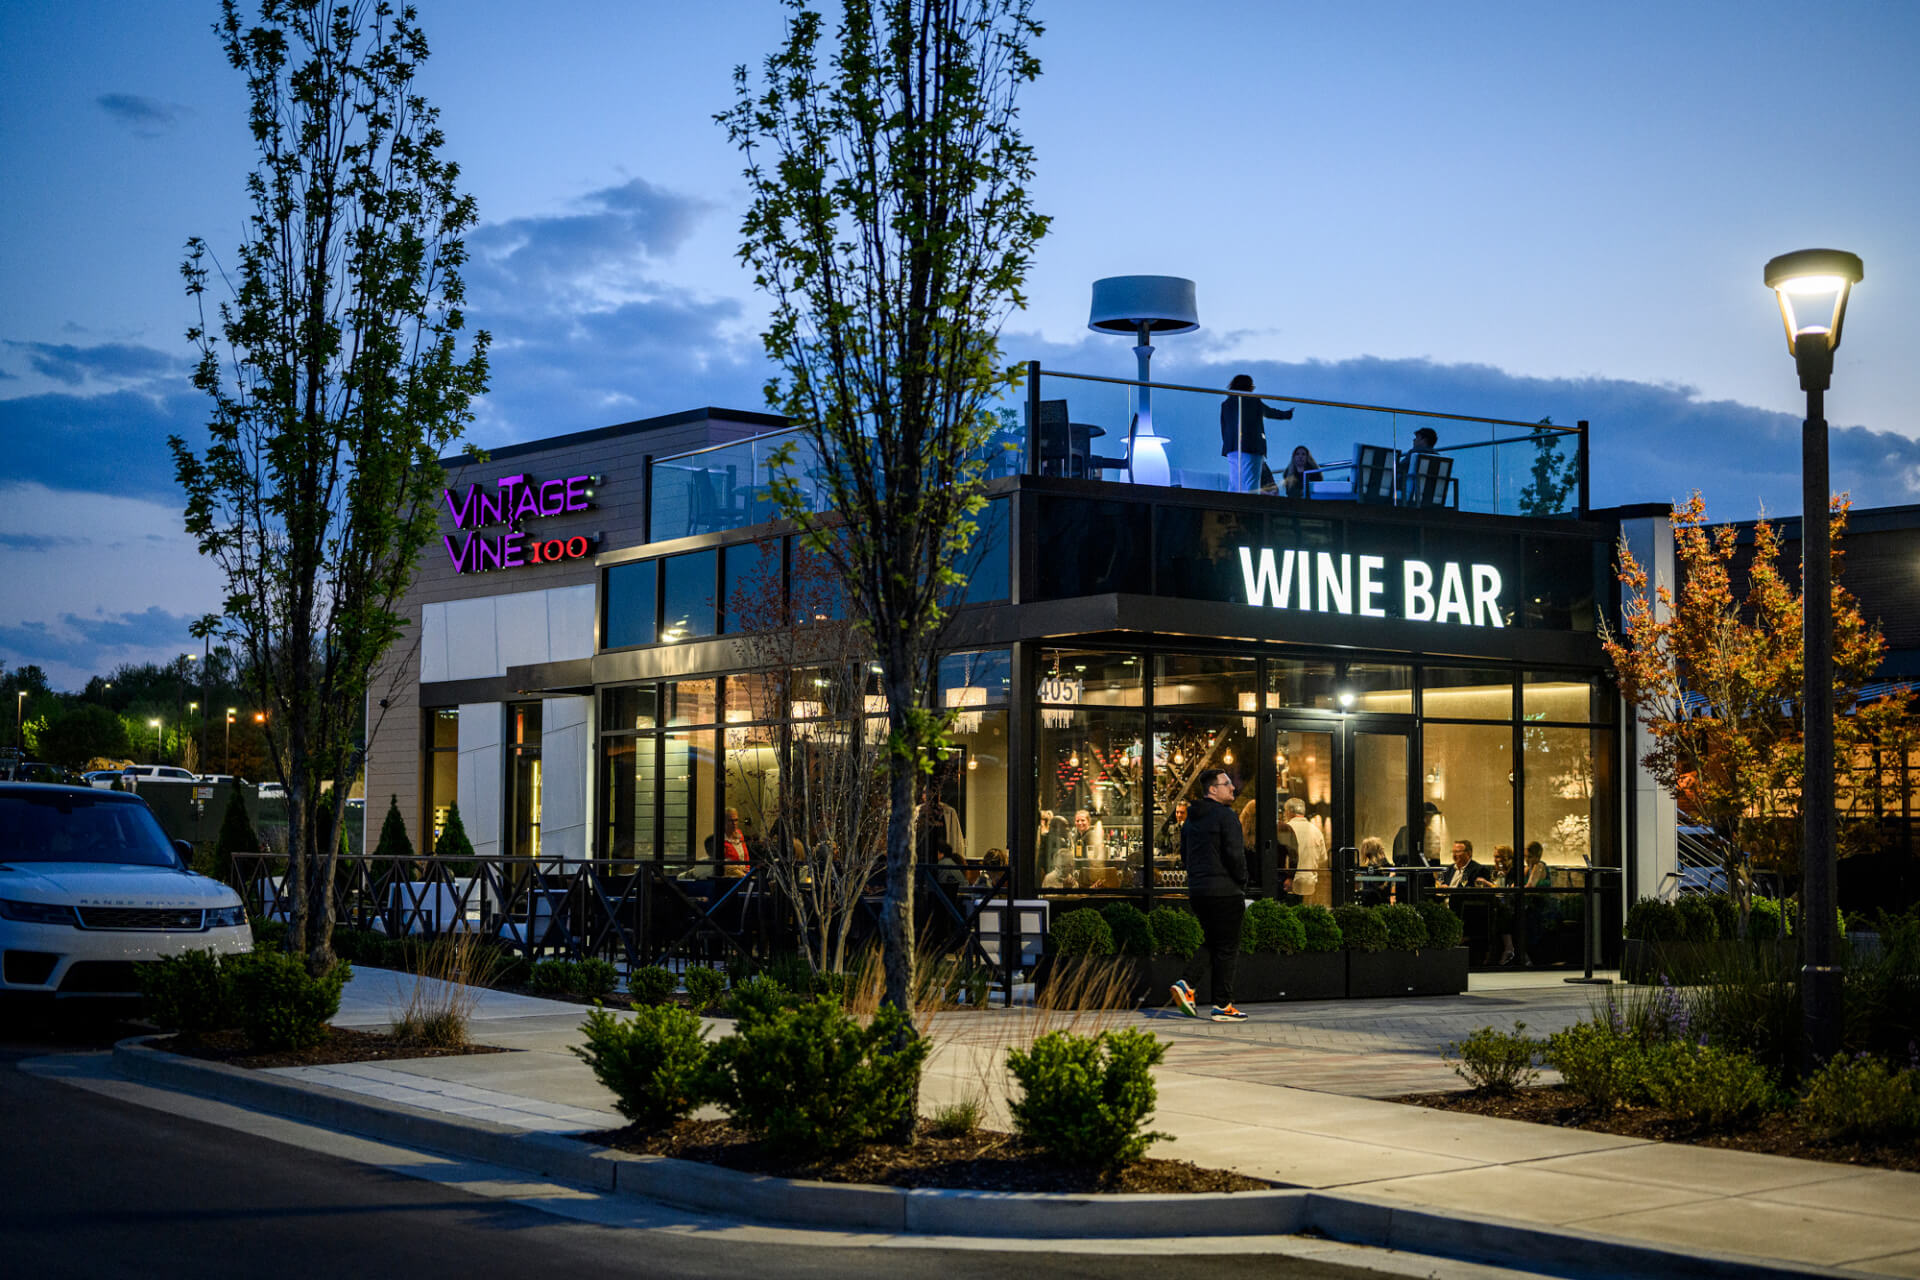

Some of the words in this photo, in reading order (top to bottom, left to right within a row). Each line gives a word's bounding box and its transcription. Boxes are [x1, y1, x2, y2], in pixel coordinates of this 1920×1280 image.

[444, 474, 588, 531] VINTAGE
[444, 531, 525, 574] VINE
[530, 536, 588, 563] 100
[1238, 546, 1386, 618] WINE
[1403, 560, 1504, 628] BAR
[1037, 677, 1084, 702] 4051
